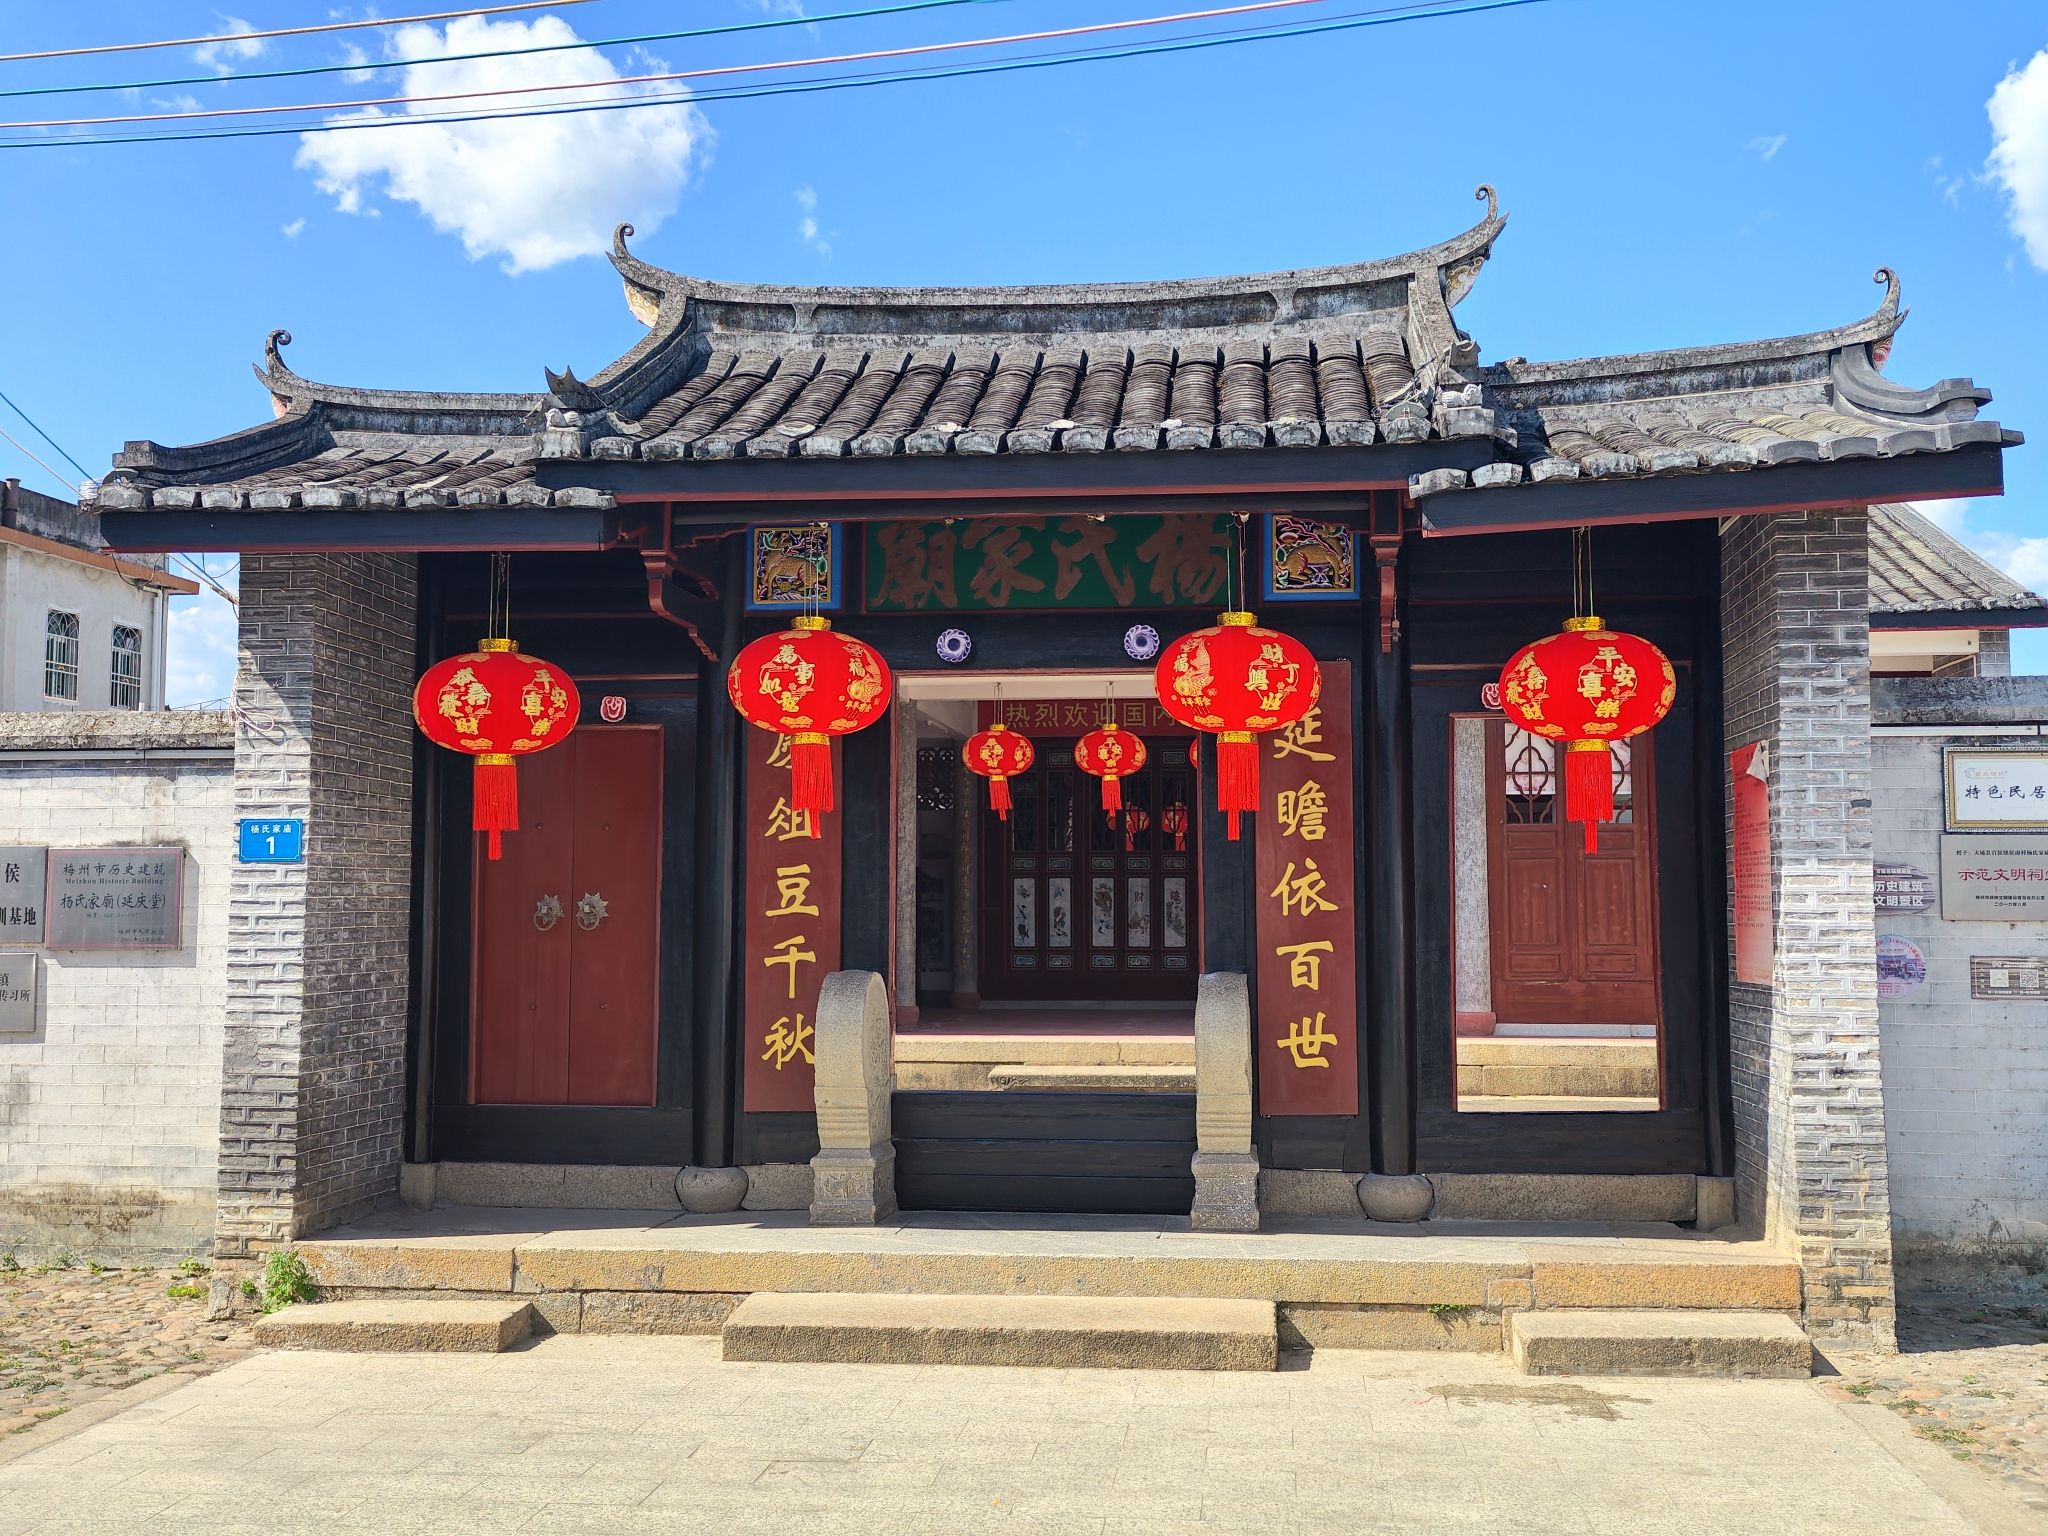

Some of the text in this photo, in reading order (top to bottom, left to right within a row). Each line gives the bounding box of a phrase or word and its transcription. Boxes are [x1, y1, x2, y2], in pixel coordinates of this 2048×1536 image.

[1965, 785, 2046, 799] 特色民居
[266, 836, 275, 854] 1
[5, 863, 20, 883] 侯
[64, 862, 166, 876] 梅州市历史建筑
[1958, 868, 2048, 881] 示范文明祠
[132, 878, 164, 886] Building
[1874, 881, 1924, 892] 历史建筑
[1874, 895, 1924, 907] 文明景区
